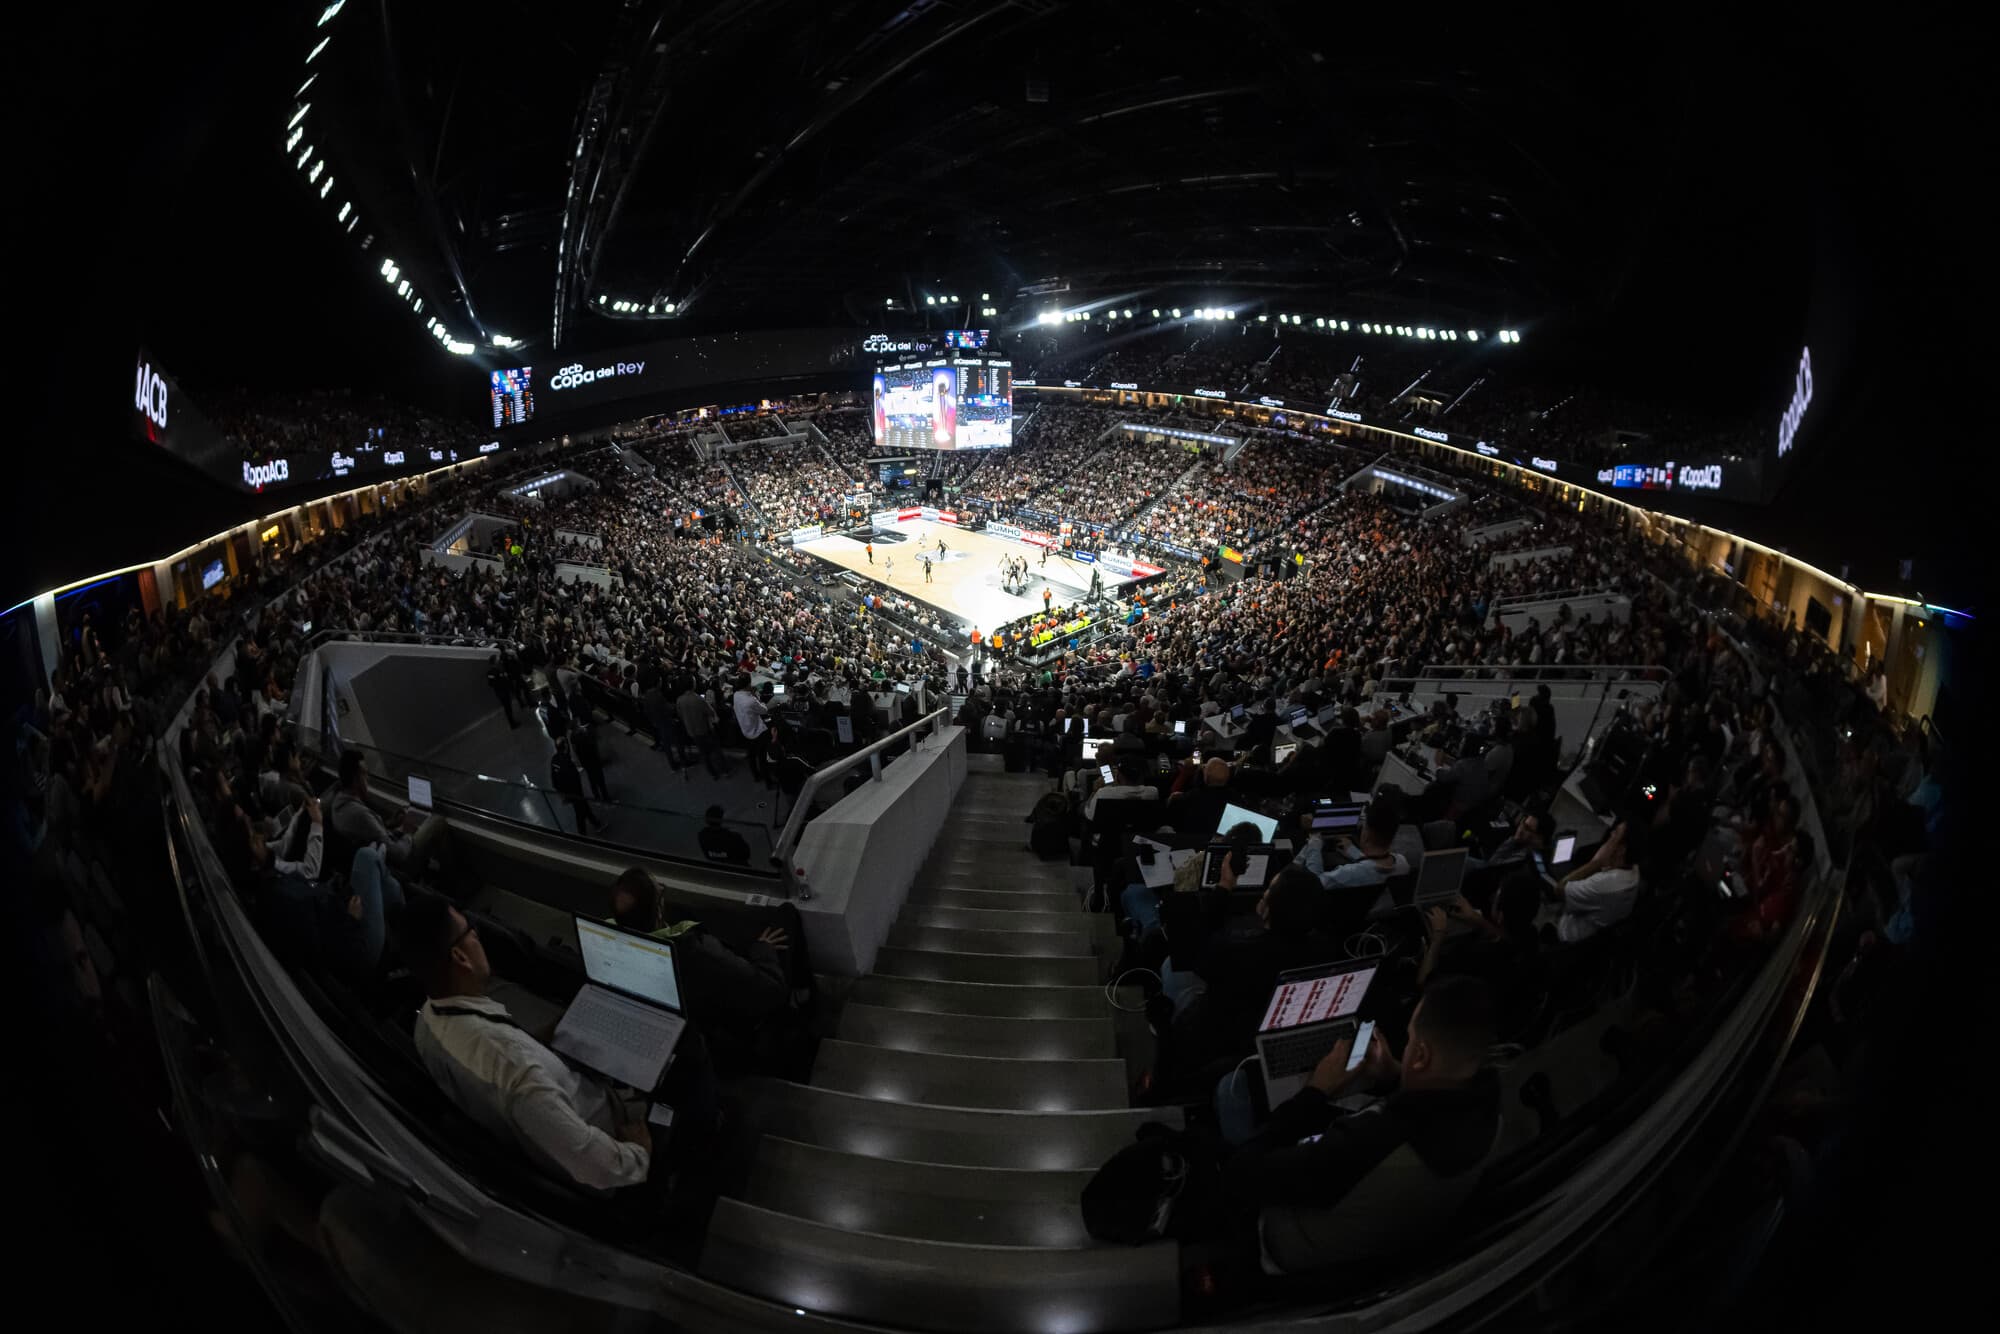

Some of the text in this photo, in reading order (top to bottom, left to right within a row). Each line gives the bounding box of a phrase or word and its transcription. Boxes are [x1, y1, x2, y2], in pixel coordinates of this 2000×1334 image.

[550, 361, 646, 391] Copa del Rey
[559, 363, 583, 377] acb
[988, 523, 1021, 537] KUMHO
